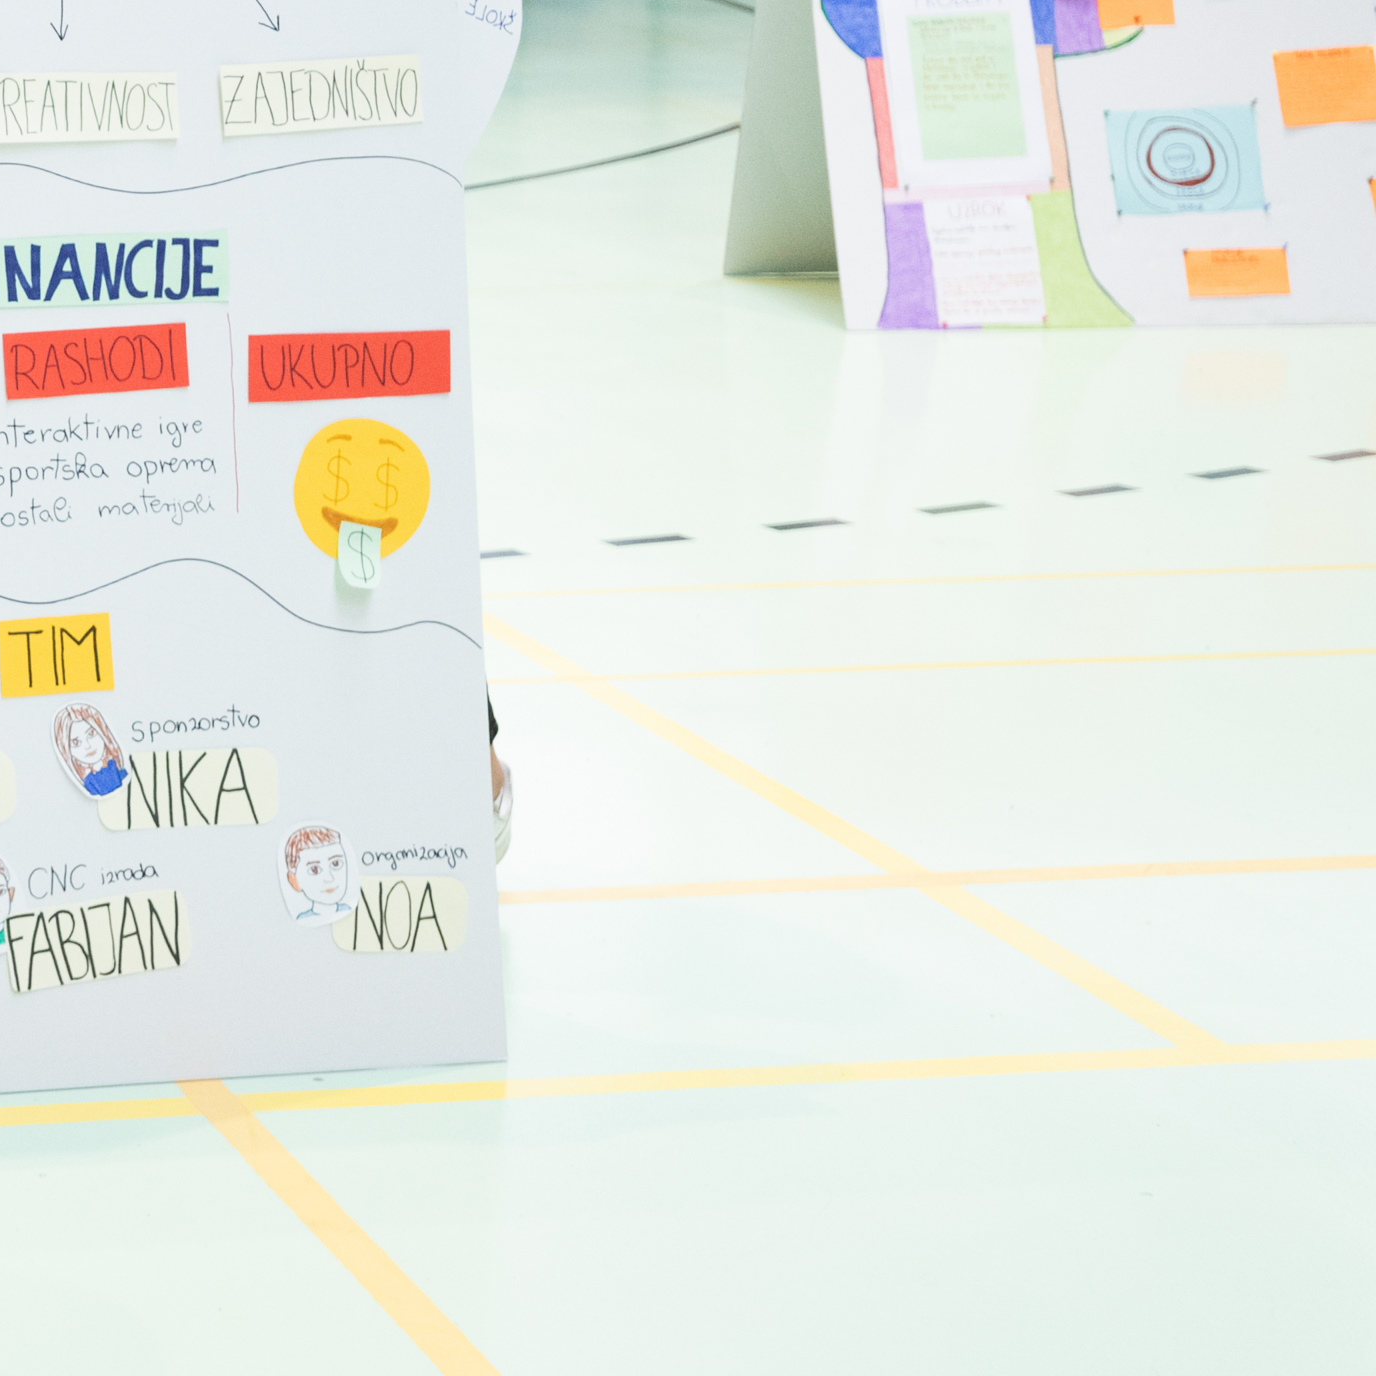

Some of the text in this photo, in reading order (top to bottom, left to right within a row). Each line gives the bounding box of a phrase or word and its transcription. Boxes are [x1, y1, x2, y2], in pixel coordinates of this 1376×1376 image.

[223, 59, 418, 127] ZAJEDNIŠTVO
[11, 328, 178, 393] RASHODI
[259, 339, 416, 393] UKUPNO
[158, 416, 203, 448] igre
[126, 457, 217, 484] oprema
[7, 624, 102, 689] TIM
[127, 748, 259, 829] NIKA
[27, 863, 159, 899] CNC izrada
[361, 843, 468, 871] organizacija
[5, 890, 181, 992] FABIJAN
[353, 880, 448, 953] NOA
